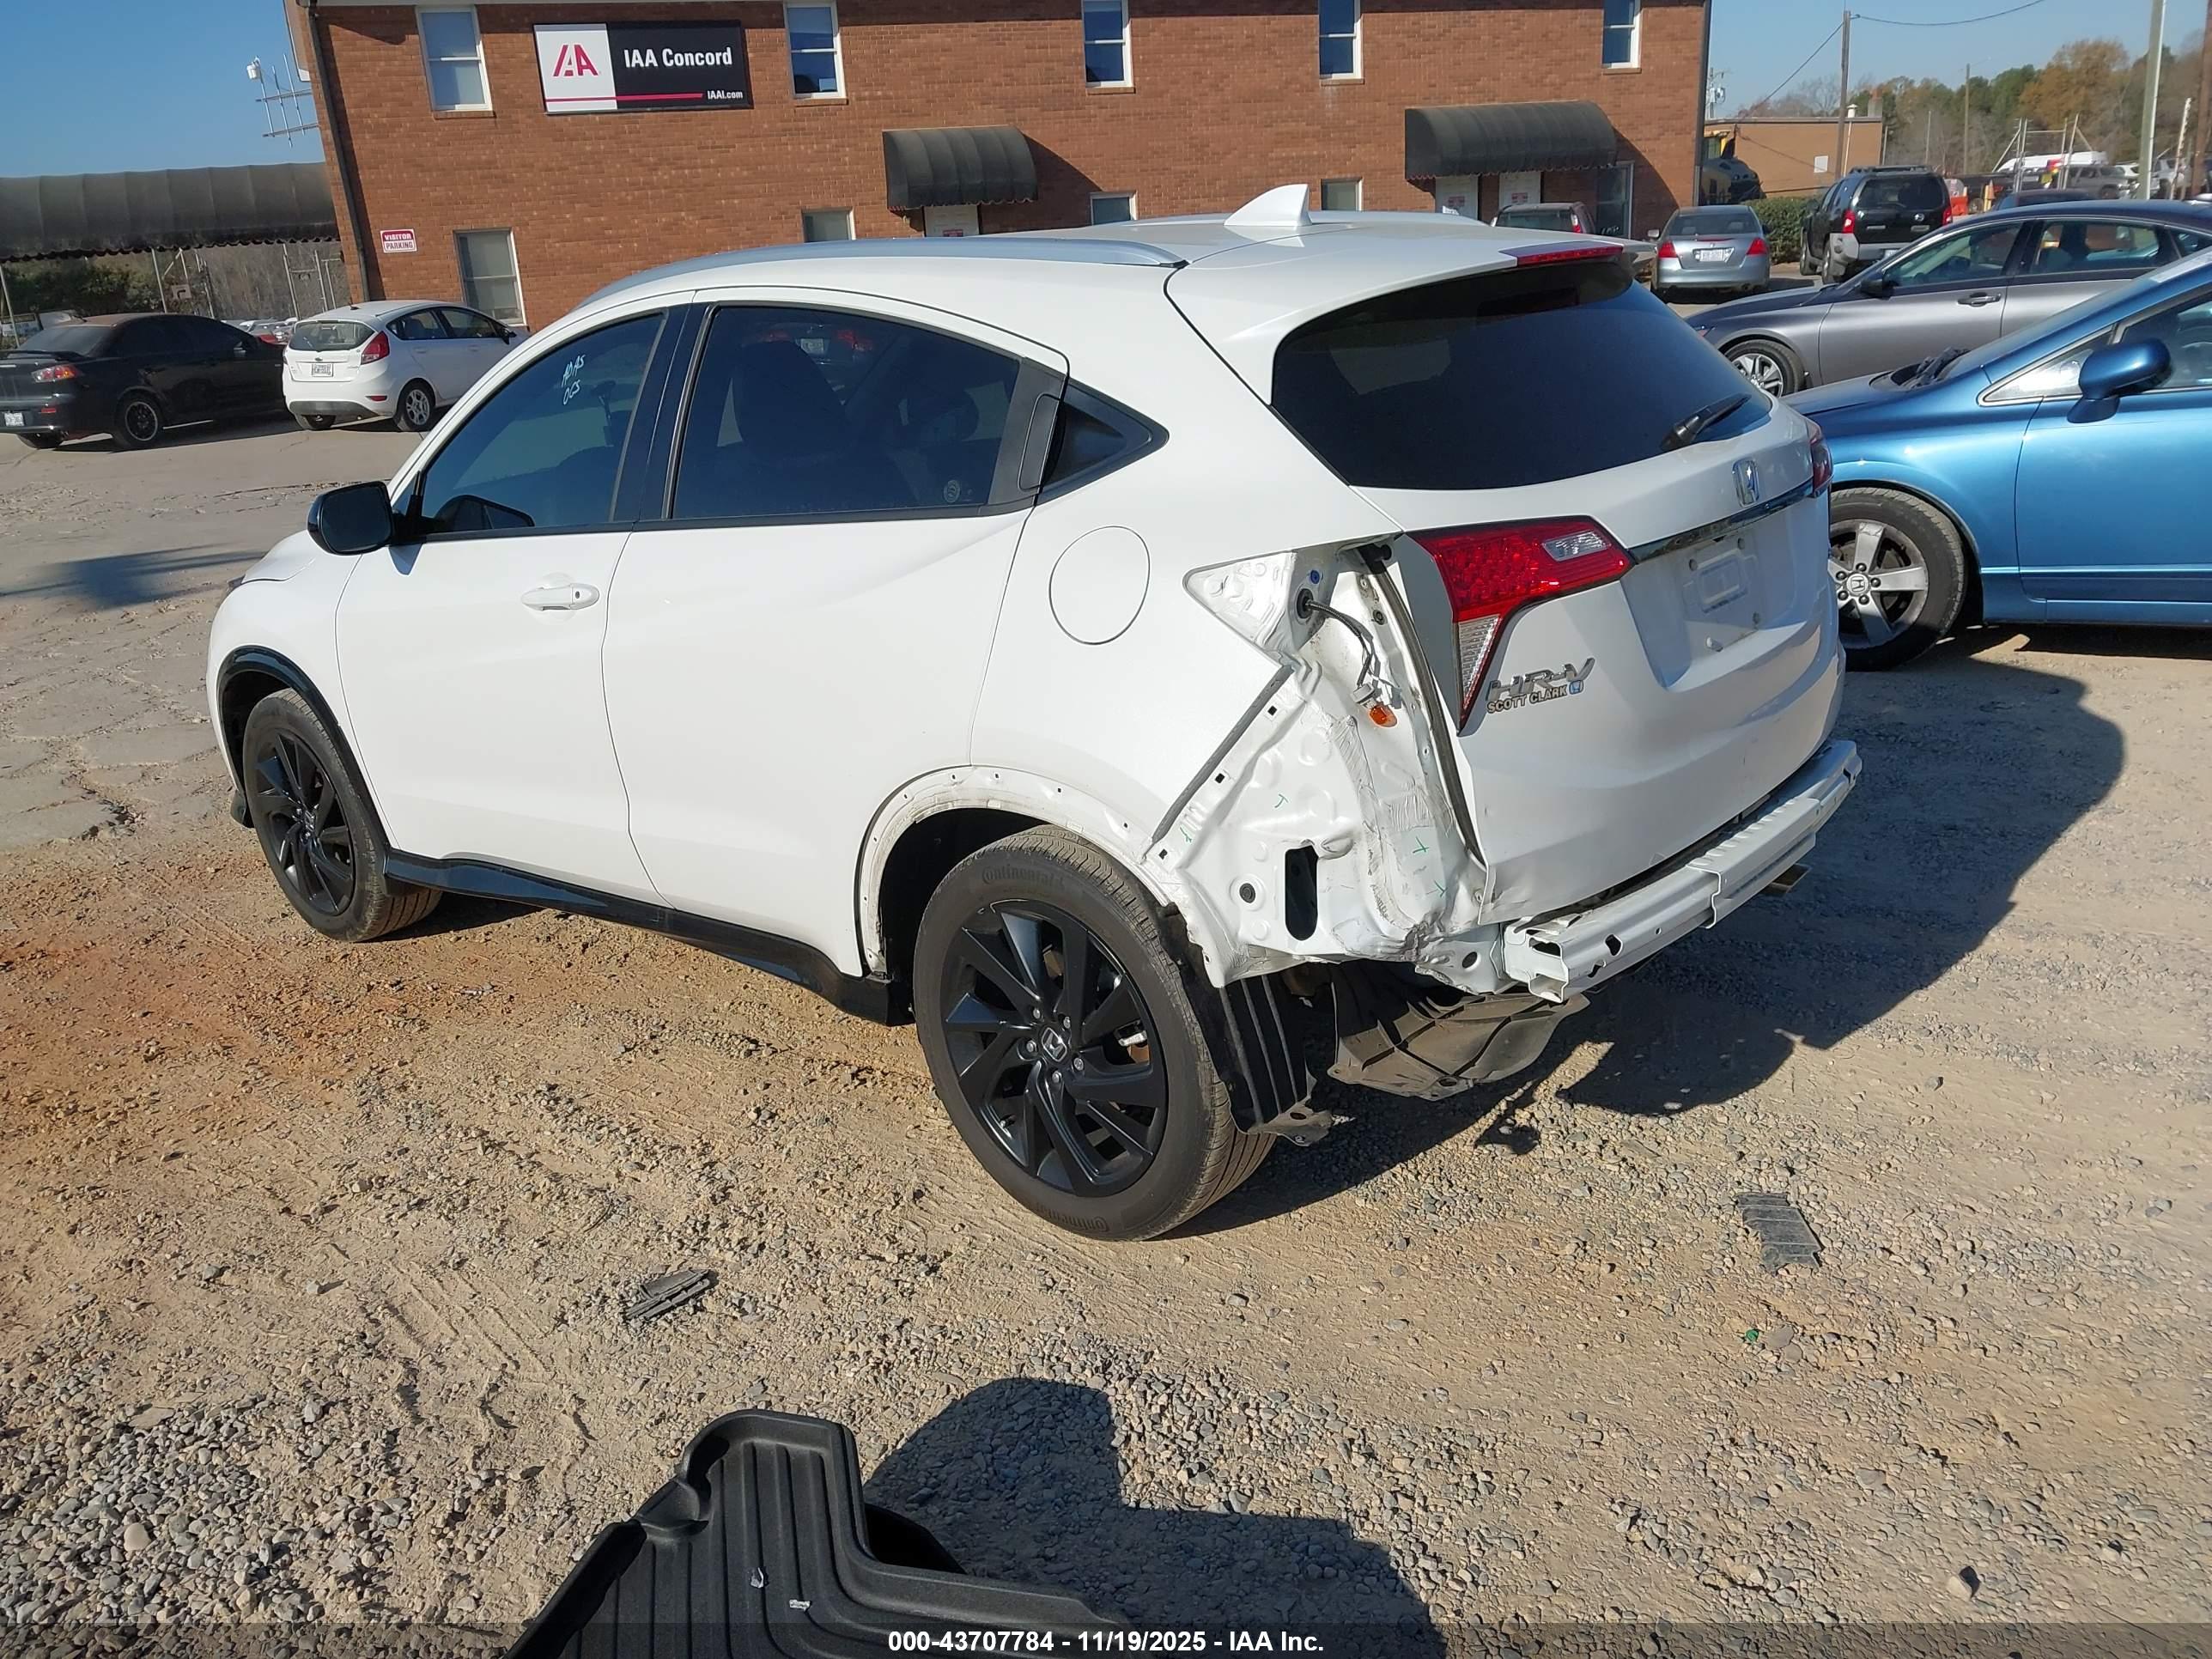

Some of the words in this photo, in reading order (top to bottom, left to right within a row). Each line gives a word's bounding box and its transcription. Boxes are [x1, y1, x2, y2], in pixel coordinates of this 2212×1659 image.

[624, 49, 659, 68] IAA
[662, 47, 732, 67] Concord
[1486, 658, 1595, 701] HR-V
[1486, 694, 1528, 714] SCOTT
[1528, 684, 1568, 705] CLARK
